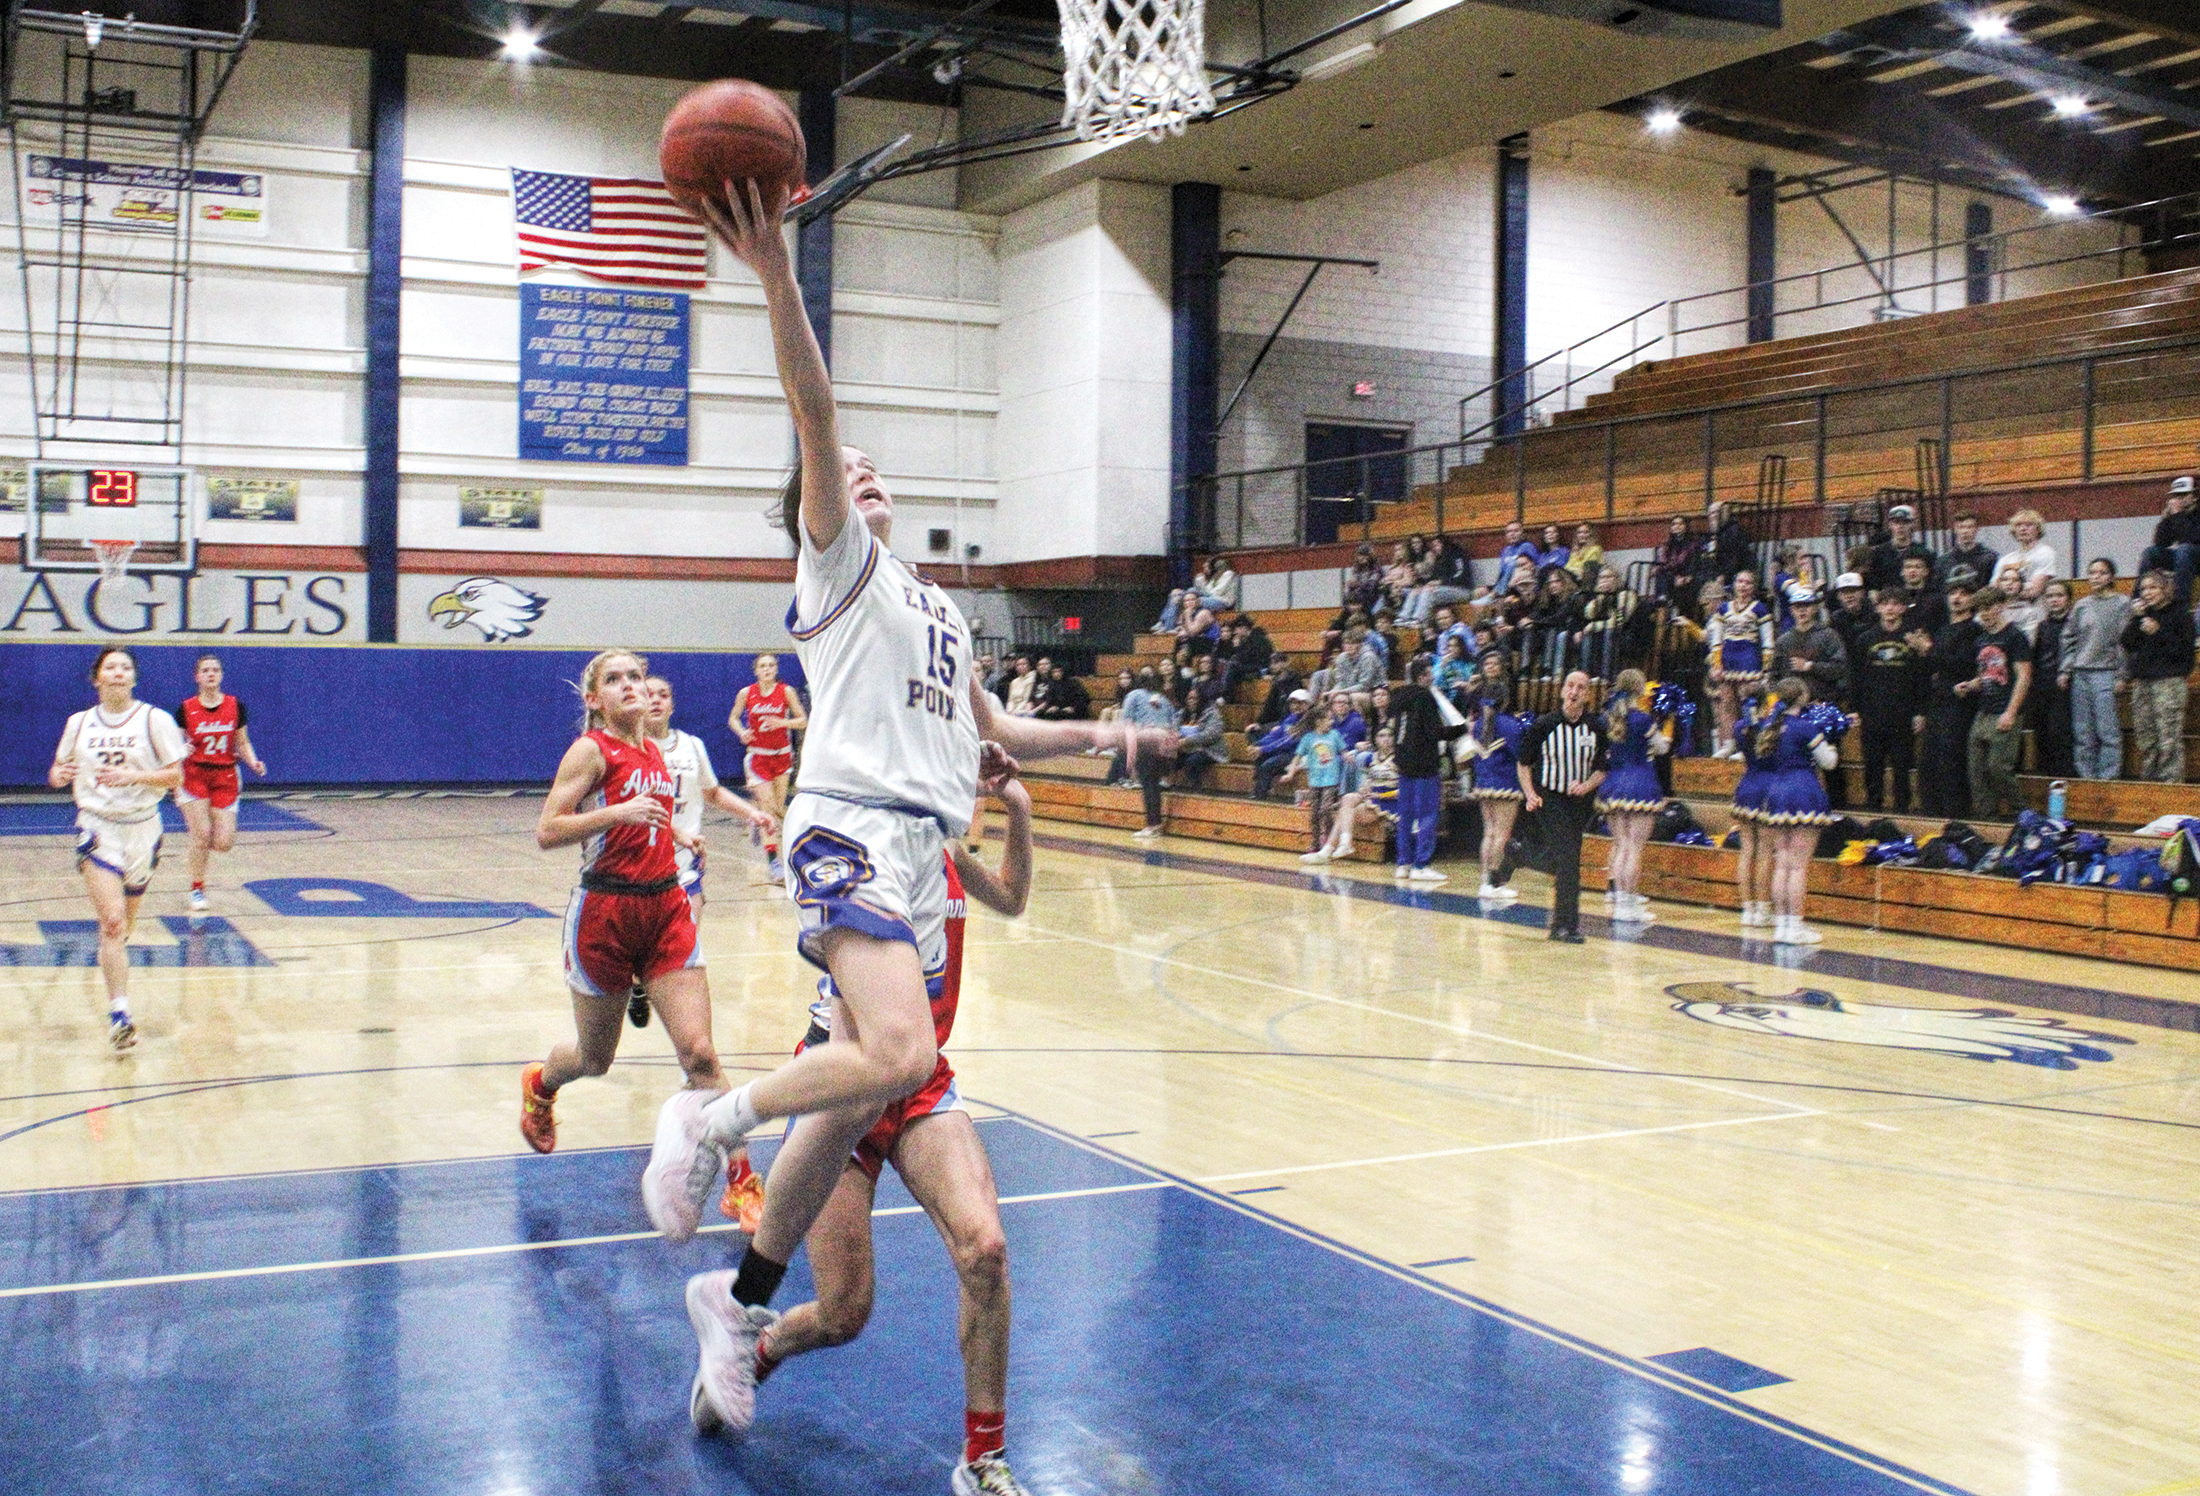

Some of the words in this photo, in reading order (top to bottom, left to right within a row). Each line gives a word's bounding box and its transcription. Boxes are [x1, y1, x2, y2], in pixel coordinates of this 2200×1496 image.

[541, 289, 584, 302] EAGLE
[587, 293, 622, 305] POINT
[91, 470, 135, 504] 23
[903, 586, 965, 638] EAG
[927, 624, 959, 688] 15
[906, 677, 957, 721] POIN
[88, 736, 136, 748] EAGLE
[202, 735, 228, 755] 24
[620, 768, 674, 798] Ashlan
